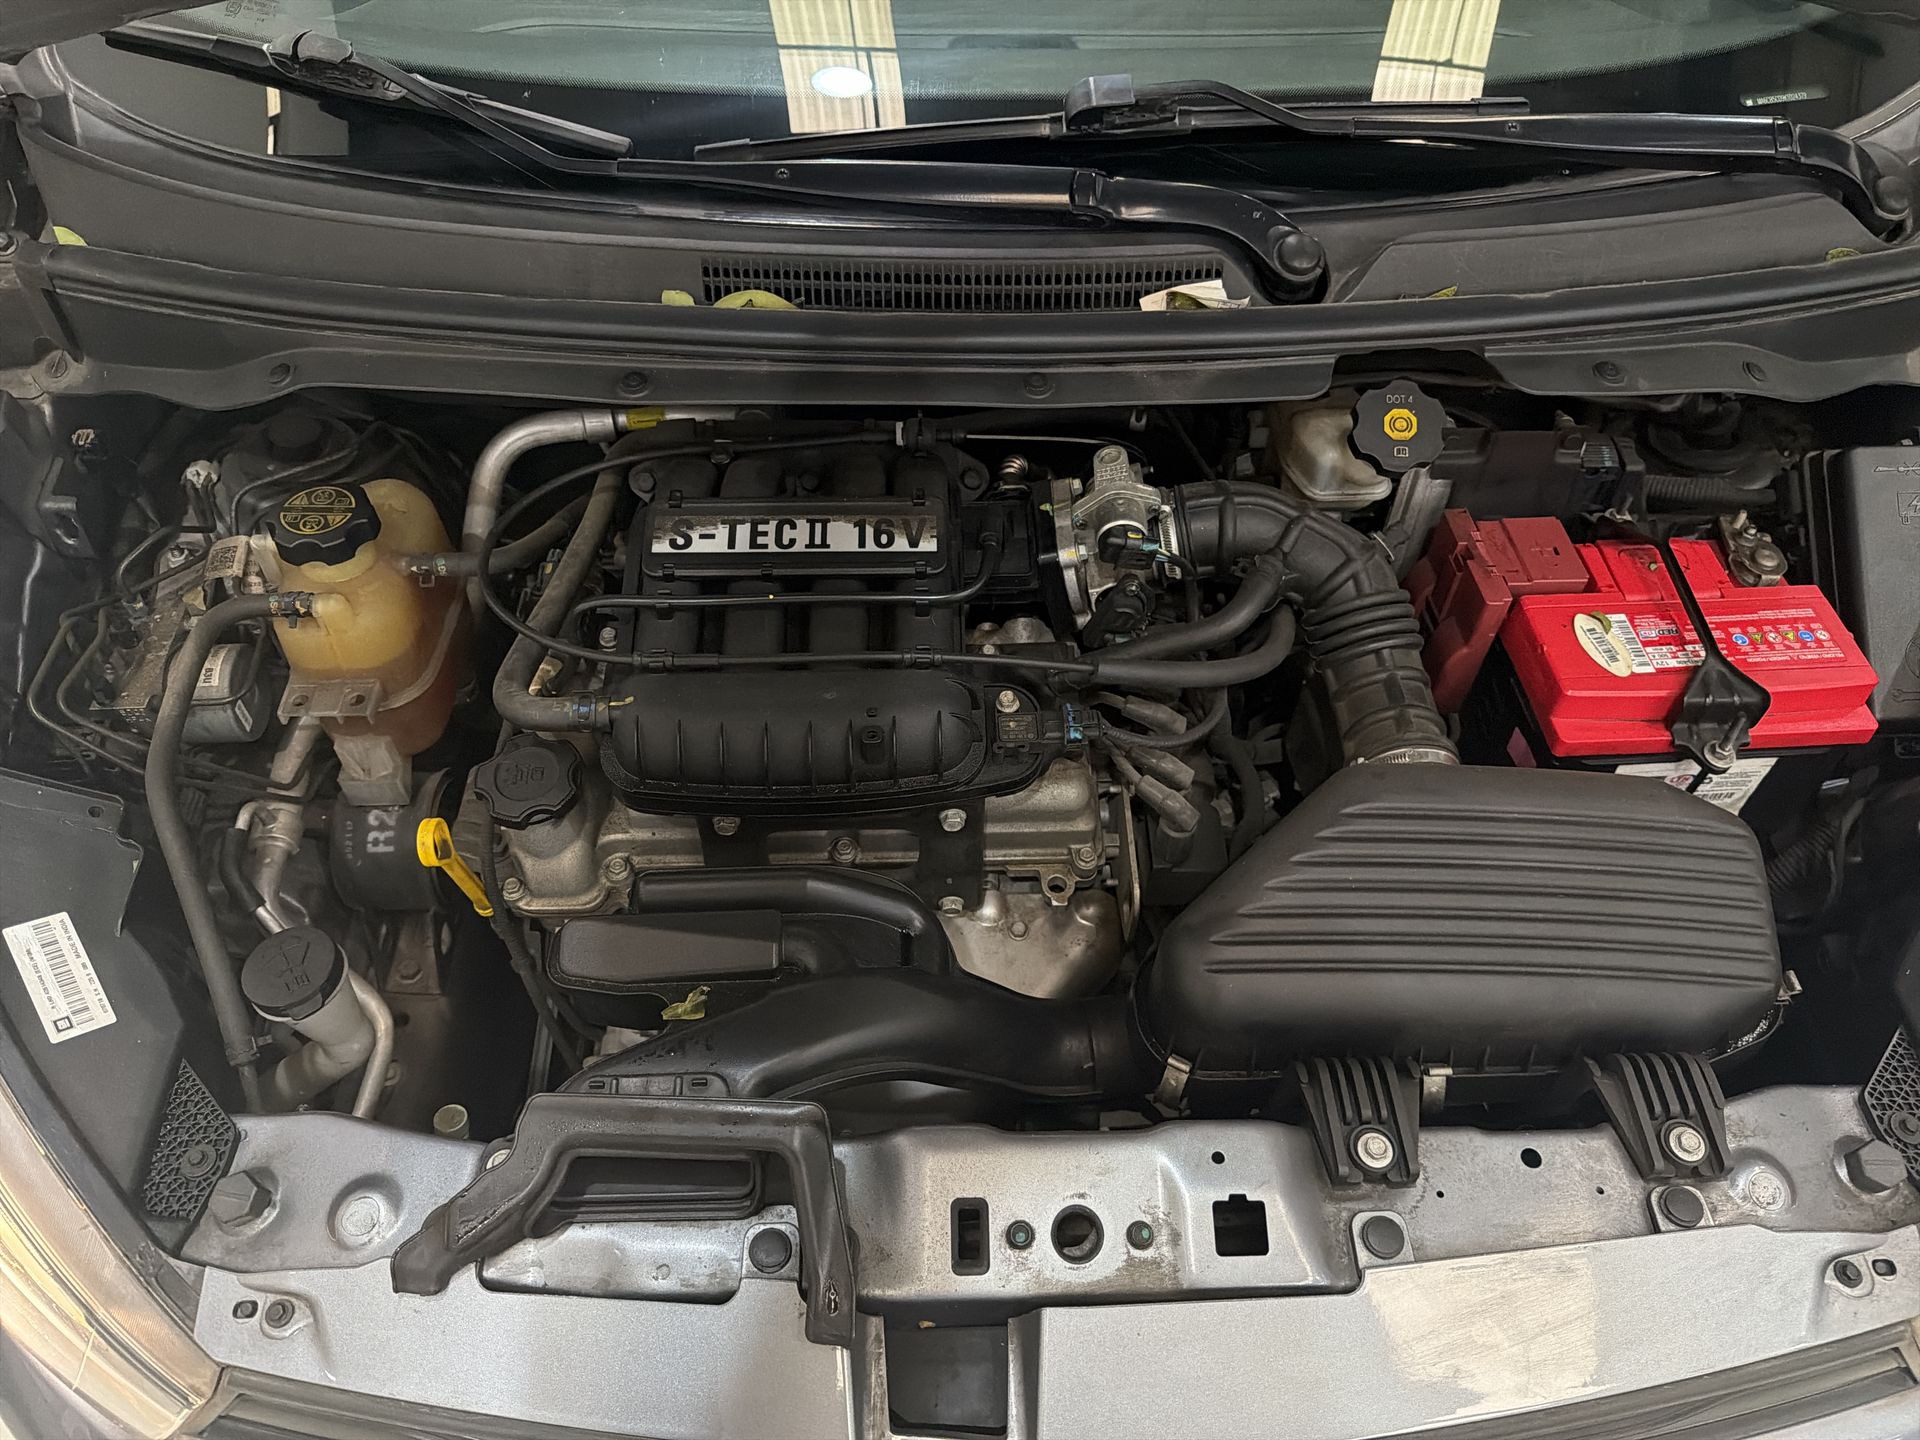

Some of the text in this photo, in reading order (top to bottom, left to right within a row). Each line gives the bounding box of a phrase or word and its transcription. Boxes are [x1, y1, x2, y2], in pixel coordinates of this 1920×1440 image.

[1386, 395, 1413, 404] DOT 4
[853, 518, 926, 549] 16V
[59, 918, 71, 936] INDIA
[69, 941, 82, 960] MADE
